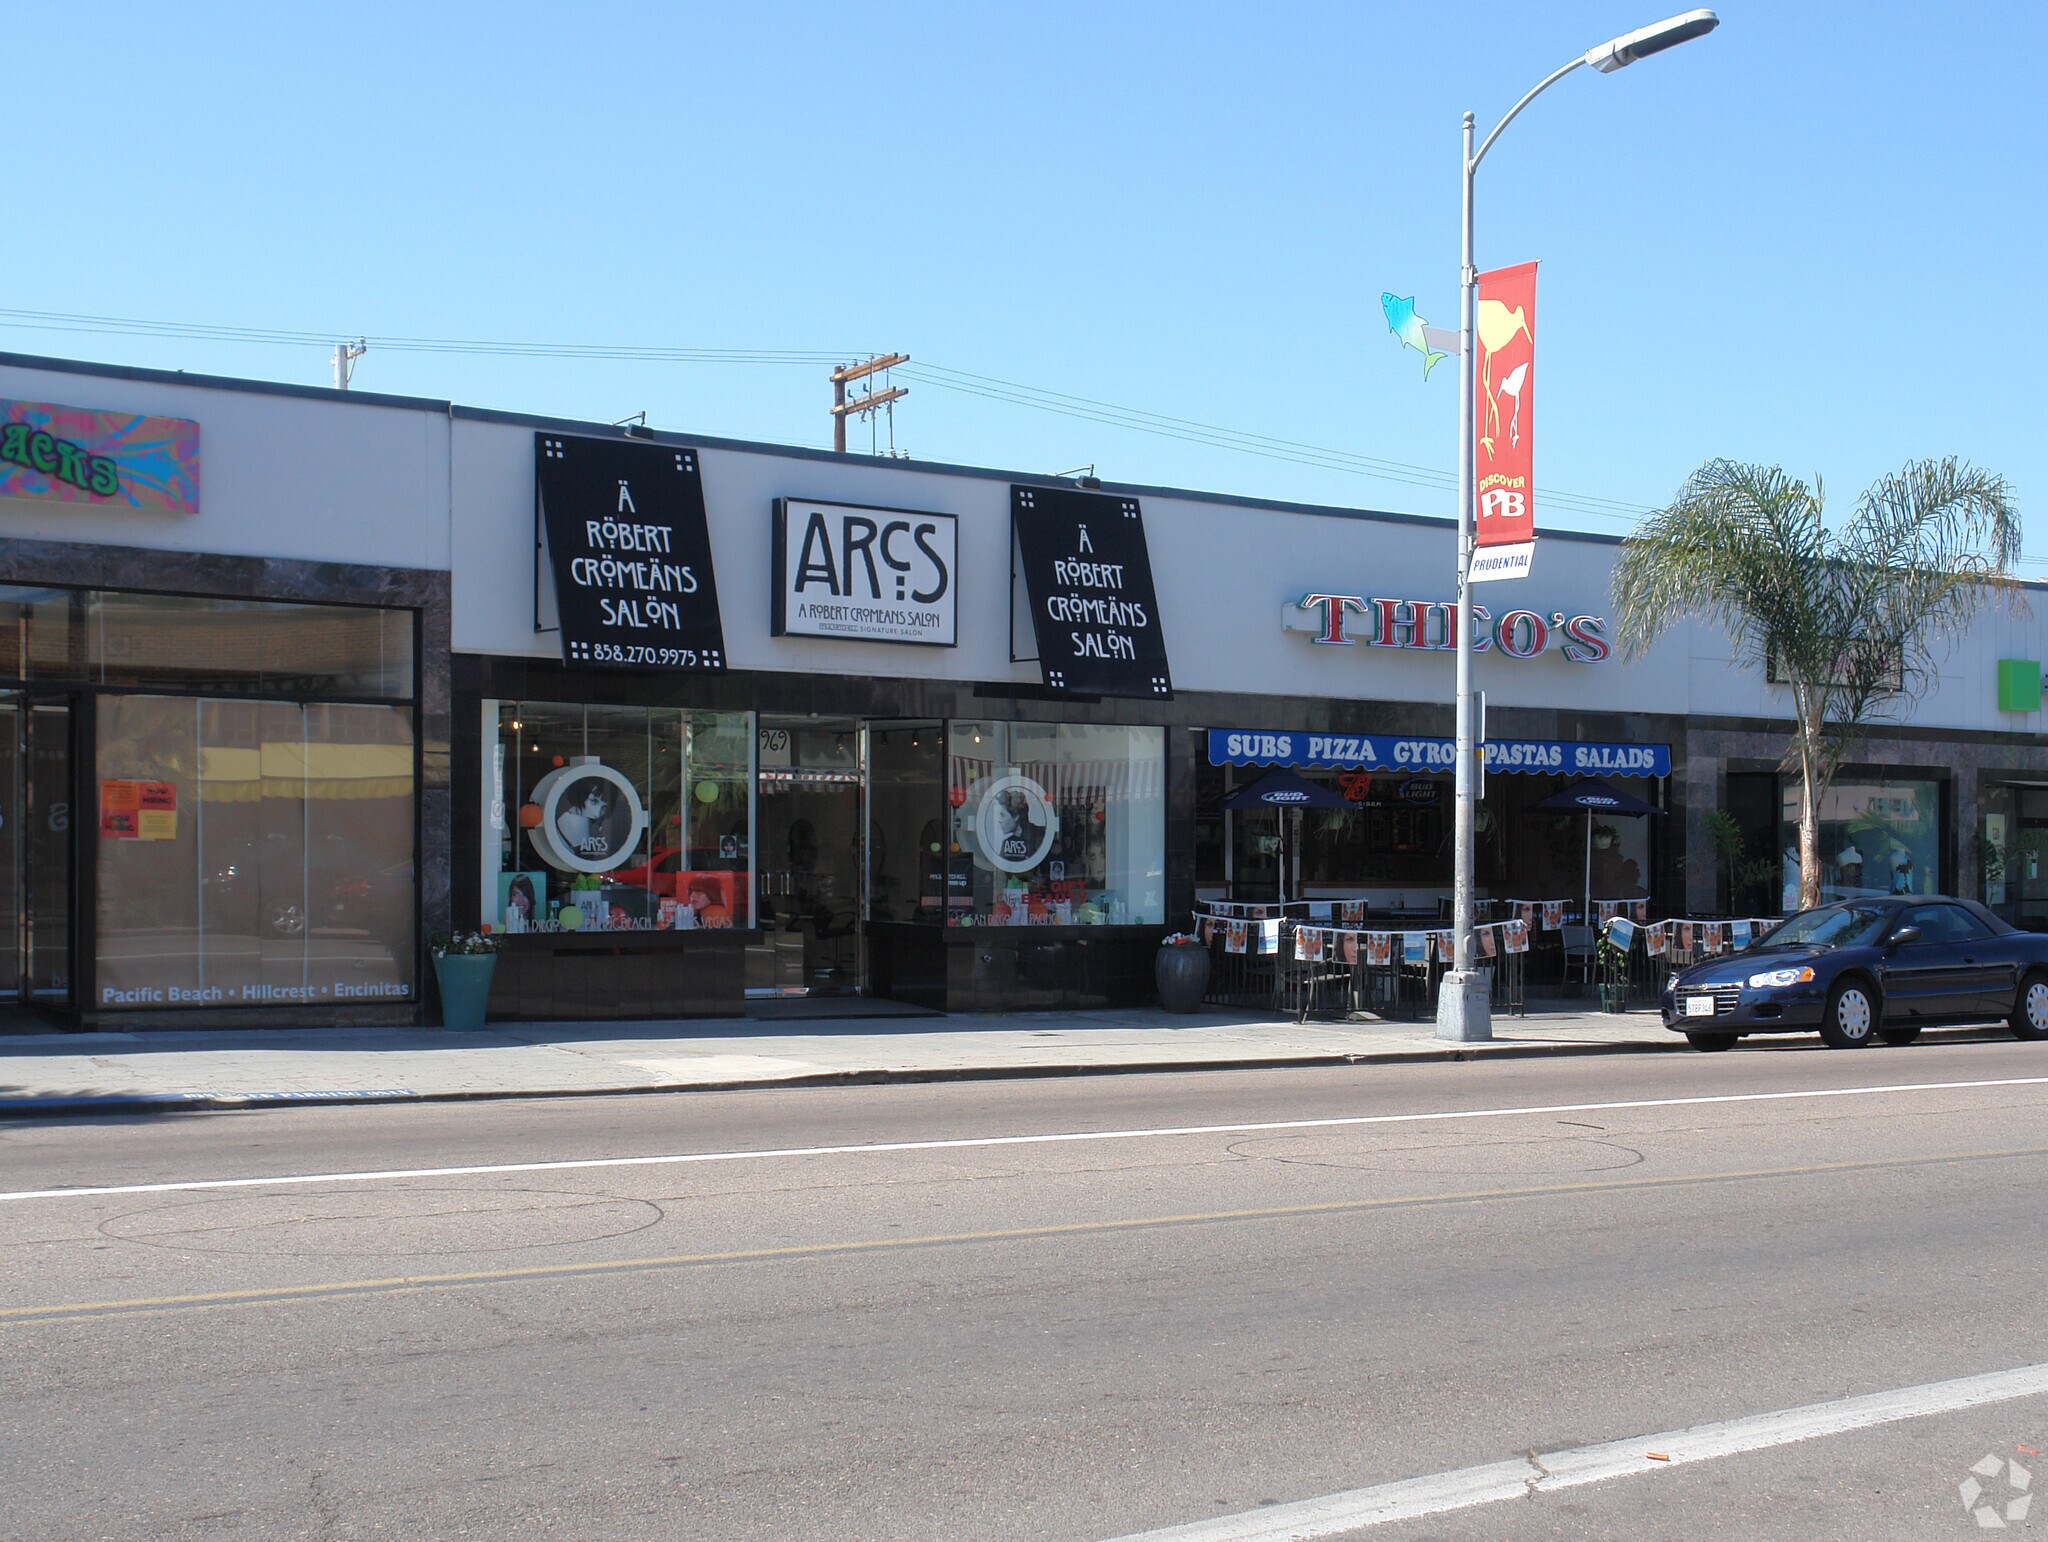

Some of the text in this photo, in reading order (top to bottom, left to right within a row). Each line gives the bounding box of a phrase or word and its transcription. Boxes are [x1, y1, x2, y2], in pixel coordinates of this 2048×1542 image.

[1480, 473, 1525, 492] DISCOVER
[1481, 488, 1525, 518] PB
[794, 512, 948, 604] ARCS
[1473, 555, 1528, 571] PRUDENTIAL
[799, 603, 940, 628] A ROBERT CROMEANS SALON
[860, 626, 898, 635] SIGNATURE
[1296, 592, 1613, 663] THEO'S
[594, 643, 697, 667] 858.270.9975
[761, 730, 788, 751] 969
[1227, 734, 1655, 769] SUBS PIZZA GYRO PASTAS SALADS
[1405, 790, 1438, 799] LIGHT
[1410, 782, 1434, 791] BUD
[1267, 794, 1311, 802] LIGHT
[580, 837, 608, 851] ARCS
[1003, 840, 1026, 853] ARCS
[1050, 881, 1088, 893] GIFT
[103, 981, 409, 1003] Pacific Beach Hillcrest Encinitas
